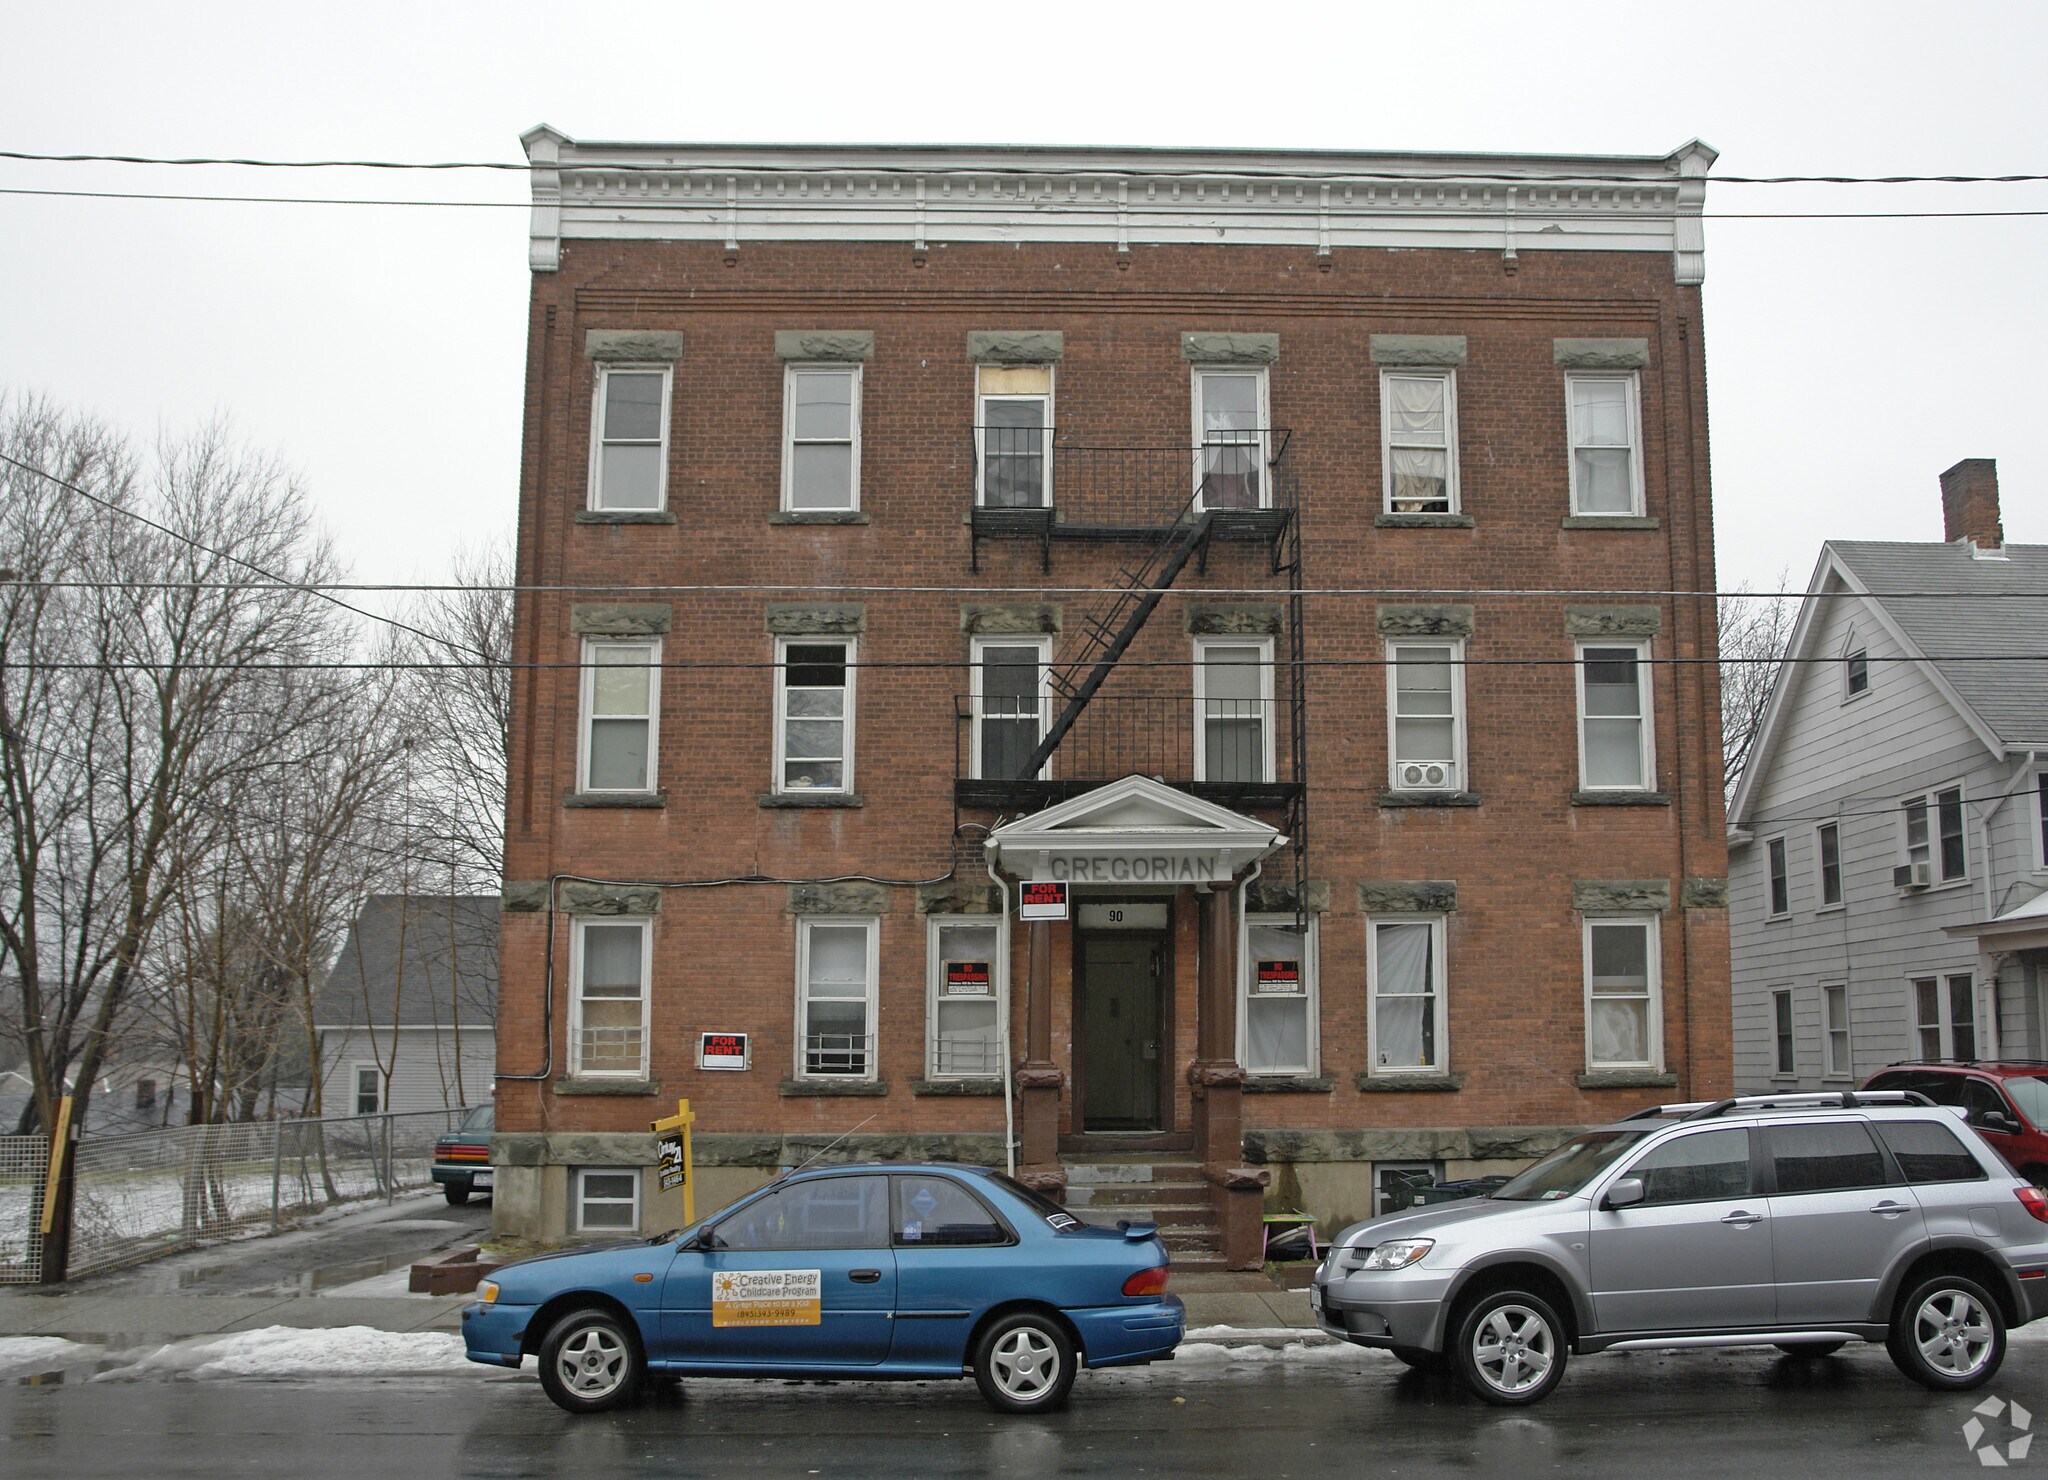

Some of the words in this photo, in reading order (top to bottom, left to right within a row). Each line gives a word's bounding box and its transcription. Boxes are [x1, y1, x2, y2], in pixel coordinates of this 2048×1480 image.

[1051, 857, 1214, 880] GREGORIAN
[1031, 884, 1057, 894] FOR
[1024, 894, 1064, 904] RENT
[1109, 910, 1123, 922] 90
[963, 964, 972, 972] NO
[1273, 962, 1282, 970] NO
[949, 973, 987, 981] TRESPASSING
[1259, 971, 1297, 979] TRESPASSING
[712, 1036, 736, 1045] FOR
[705, 1045, 742, 1055] RENT
[658, 1141, 676, 1158] Century
[674, 1146, 683, 1164] 21
[740, 1273, 782, 1286] Creative
[784, 1273, 818, 1285] Energy
[740, 1287, 780, 1298] Childcare
[782, 1286, 817, 1297] Program
[733, 1301, 753, 1309] Great
